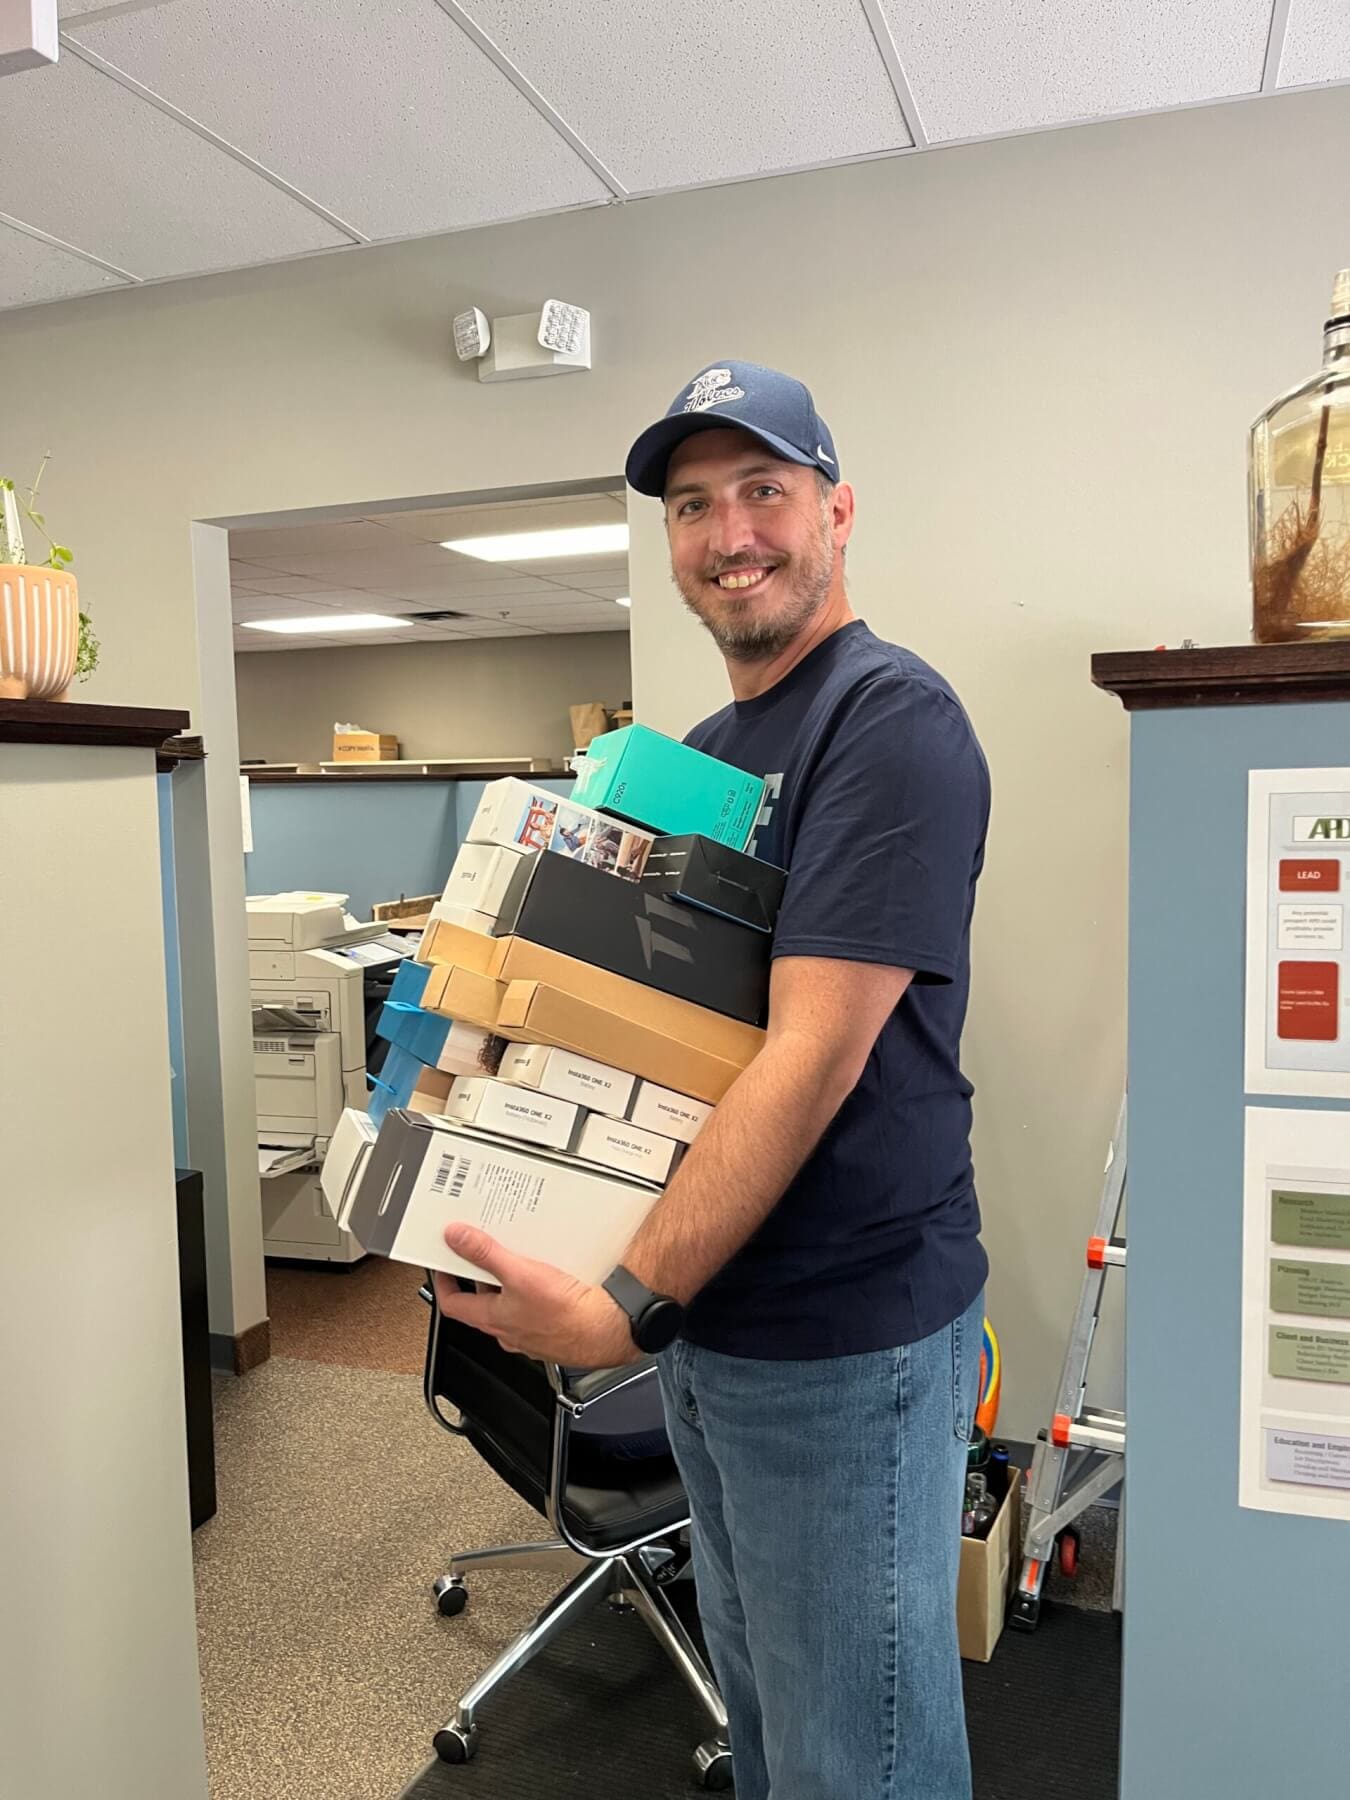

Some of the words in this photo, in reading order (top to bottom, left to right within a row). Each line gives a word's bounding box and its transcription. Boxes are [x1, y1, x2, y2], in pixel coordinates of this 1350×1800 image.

[613, 782, 627, 805] C920s
[1296, 871, 1321, 880] LEAD
[591, 1077, 603, 1086] ONE
[604, 1081, 613, 1089] X2
[504, 1103, 530, 1114] Insta360
[530, 1109, 543, 1119] ONE
[544, 1113, 553, 1121] X2
[631, 1143, 643, 1153] ONE
[644, 1147, 652, 1155] X2
[1277, 1264, 1310, 1277] Planning
[1276, 1331, 1298, 1340] Client
[1315, 1335, 1349, 1345] Business
[1274, 1436, 1310, 1447] Education
